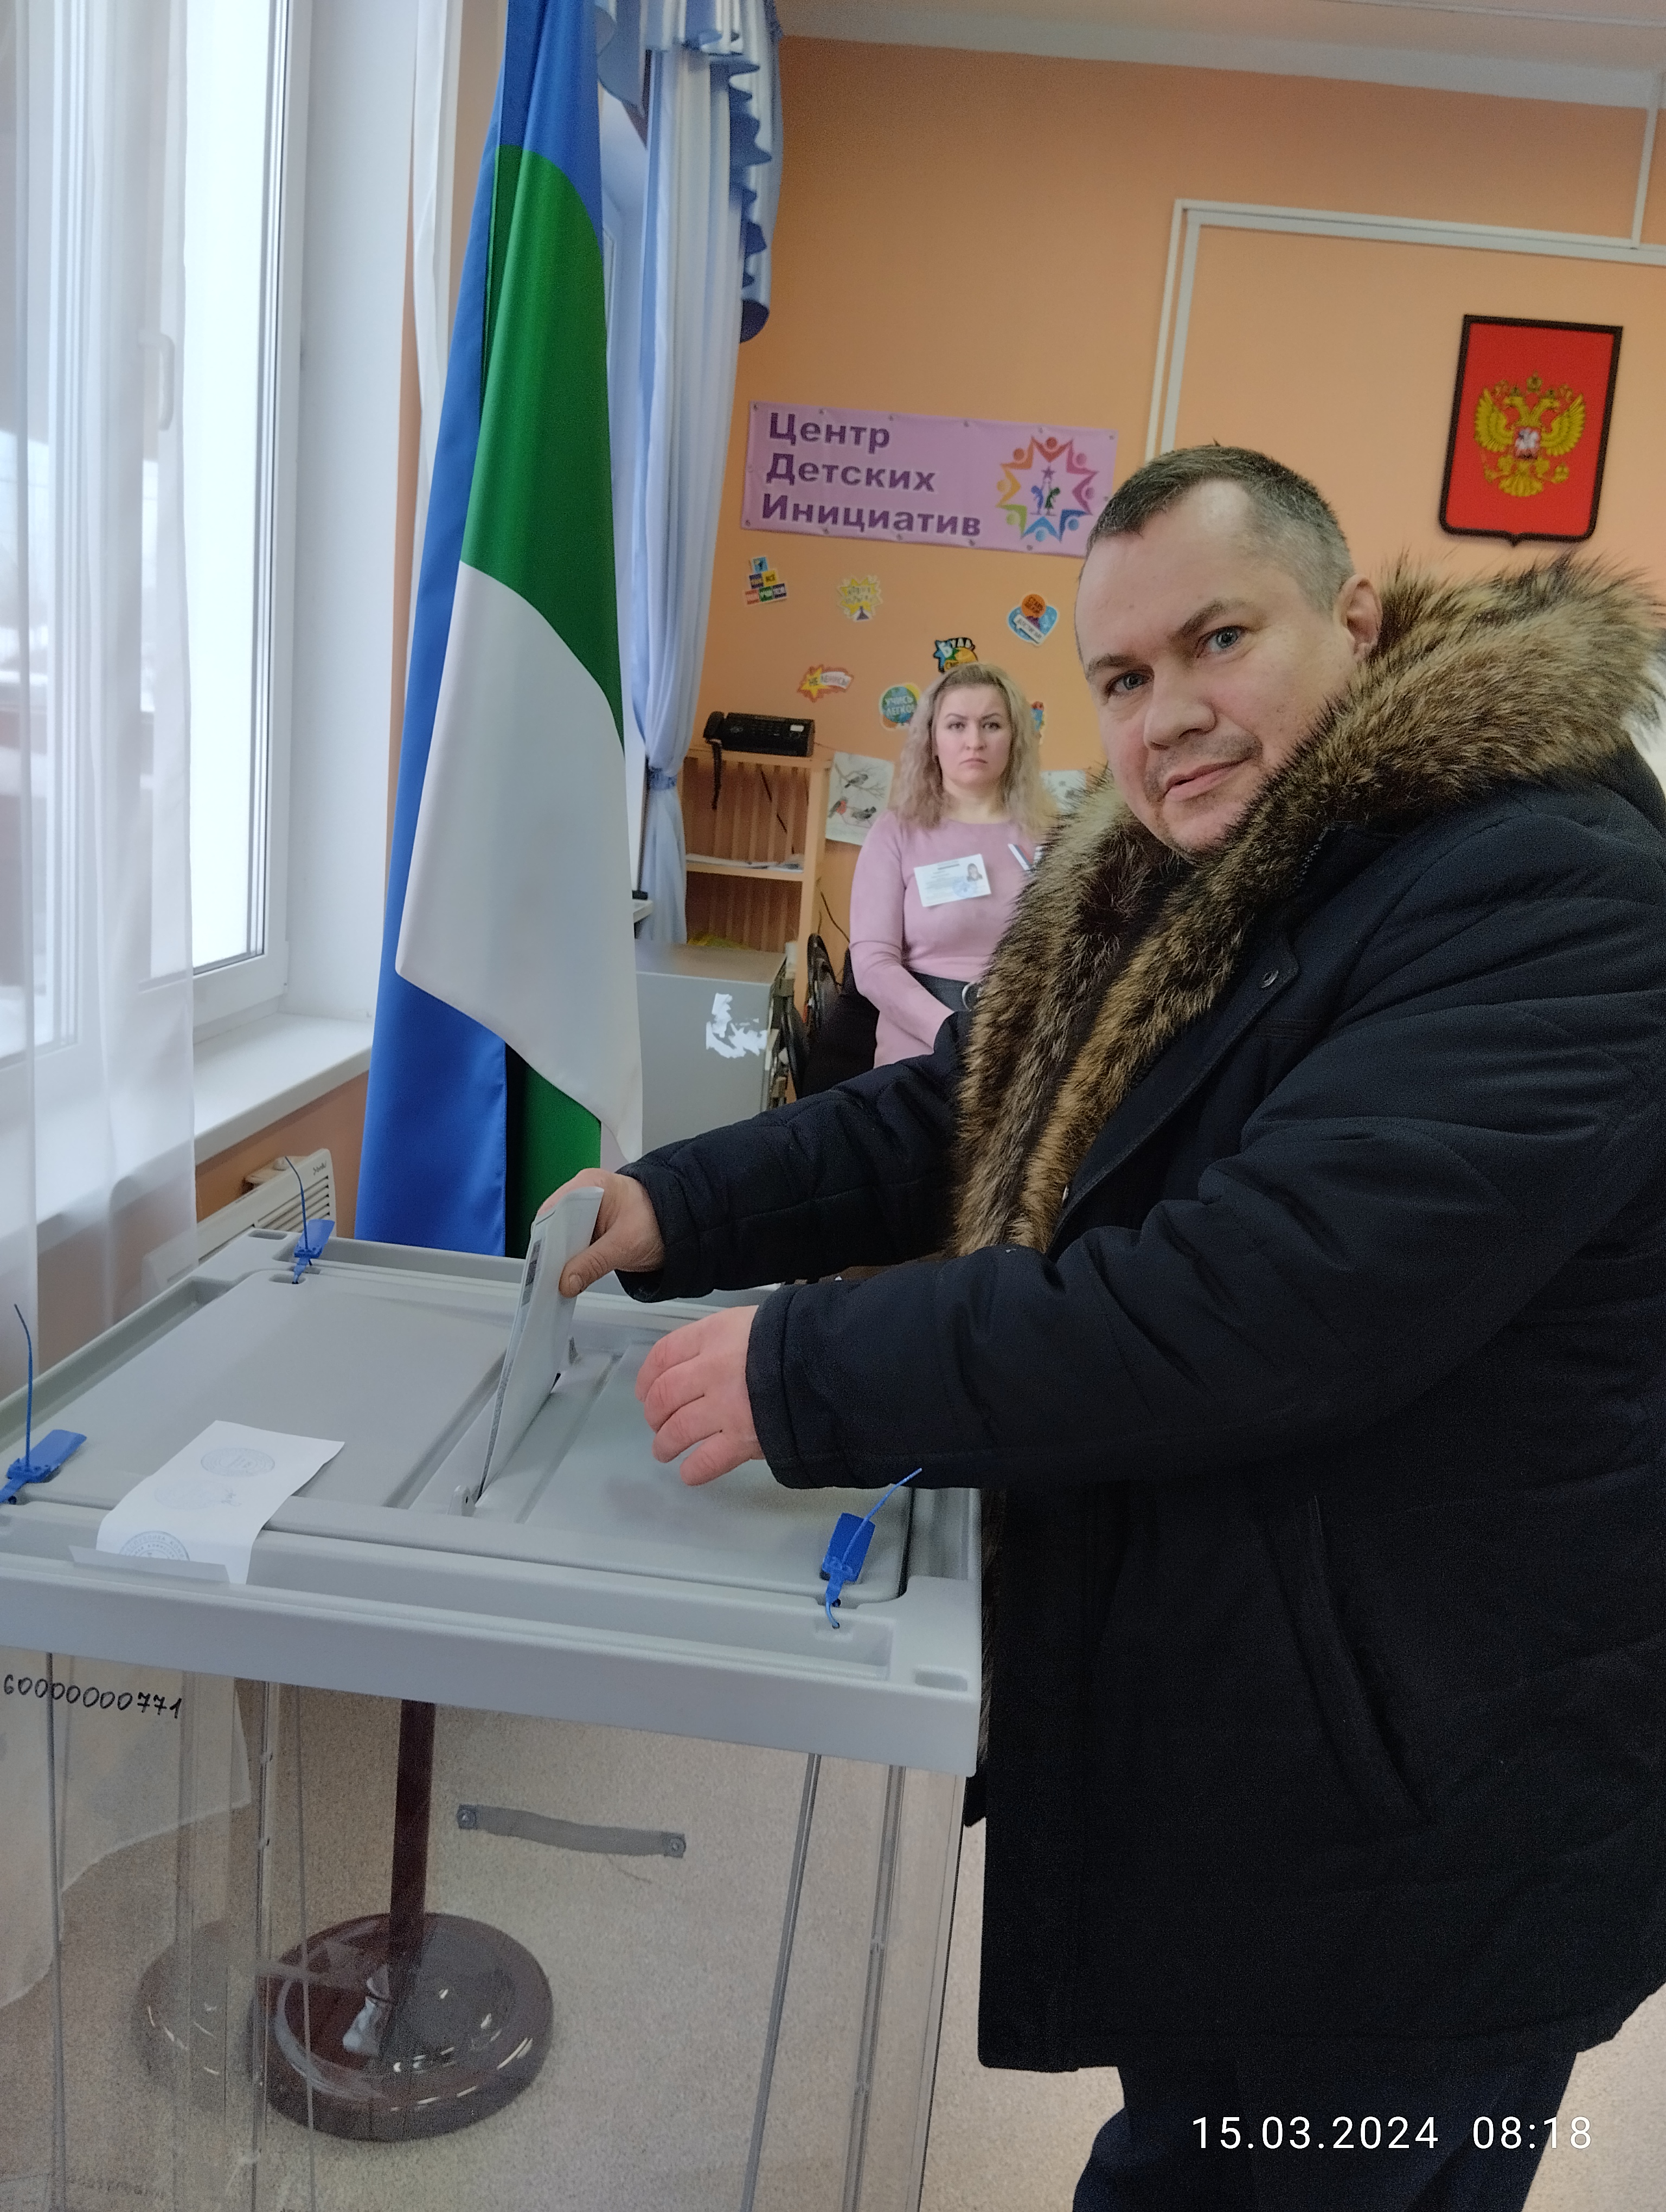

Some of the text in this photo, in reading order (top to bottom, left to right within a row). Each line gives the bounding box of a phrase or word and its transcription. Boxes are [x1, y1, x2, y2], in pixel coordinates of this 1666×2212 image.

[768, 411, 891, 454] Центр
[765, 452, 935, 492] Детских
[761, 492, 981, 537] Инициатив
[885, 695, 914, 707] УЧИСЬ
[3, 1674, 182, 1719] 60000000771
